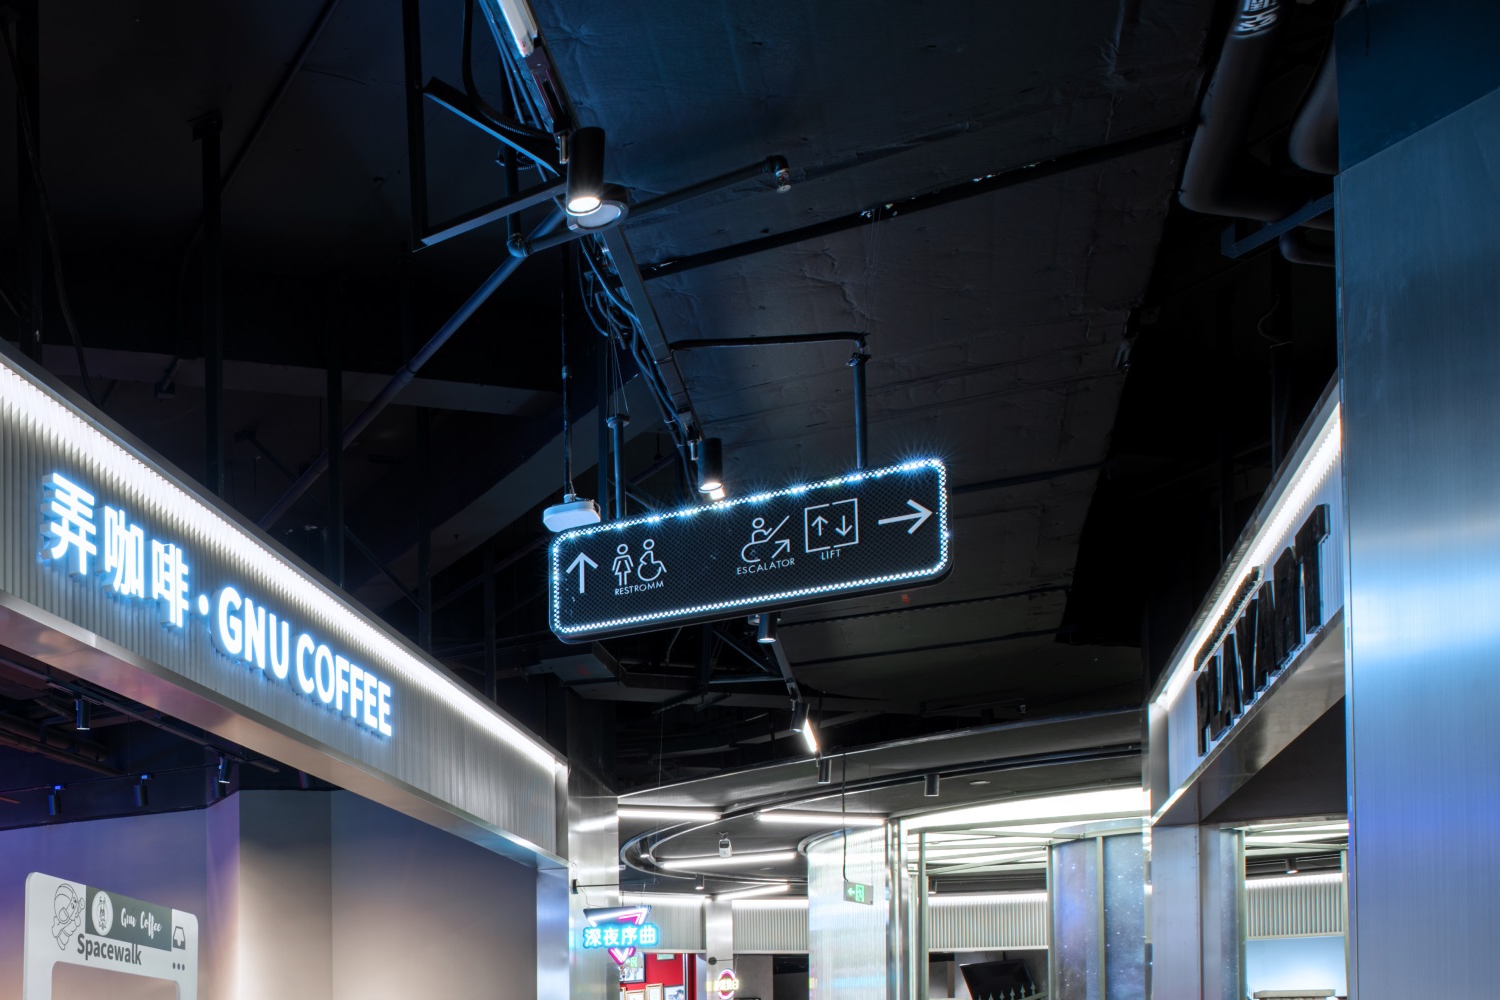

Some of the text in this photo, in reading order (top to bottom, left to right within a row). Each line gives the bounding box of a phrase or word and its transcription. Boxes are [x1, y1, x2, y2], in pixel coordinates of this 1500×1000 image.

[614, 549, 842, 595] RESTROMM ESCALATOR LIFT
[216, 586, 290, 680] GNU
[295, 632, 393, 738] COFFEE
[140, 911, 163, 940] Coffee
[583, 925, 659, 949] 深夜序曲
[76, 933, 143, 966] Spacewalk
